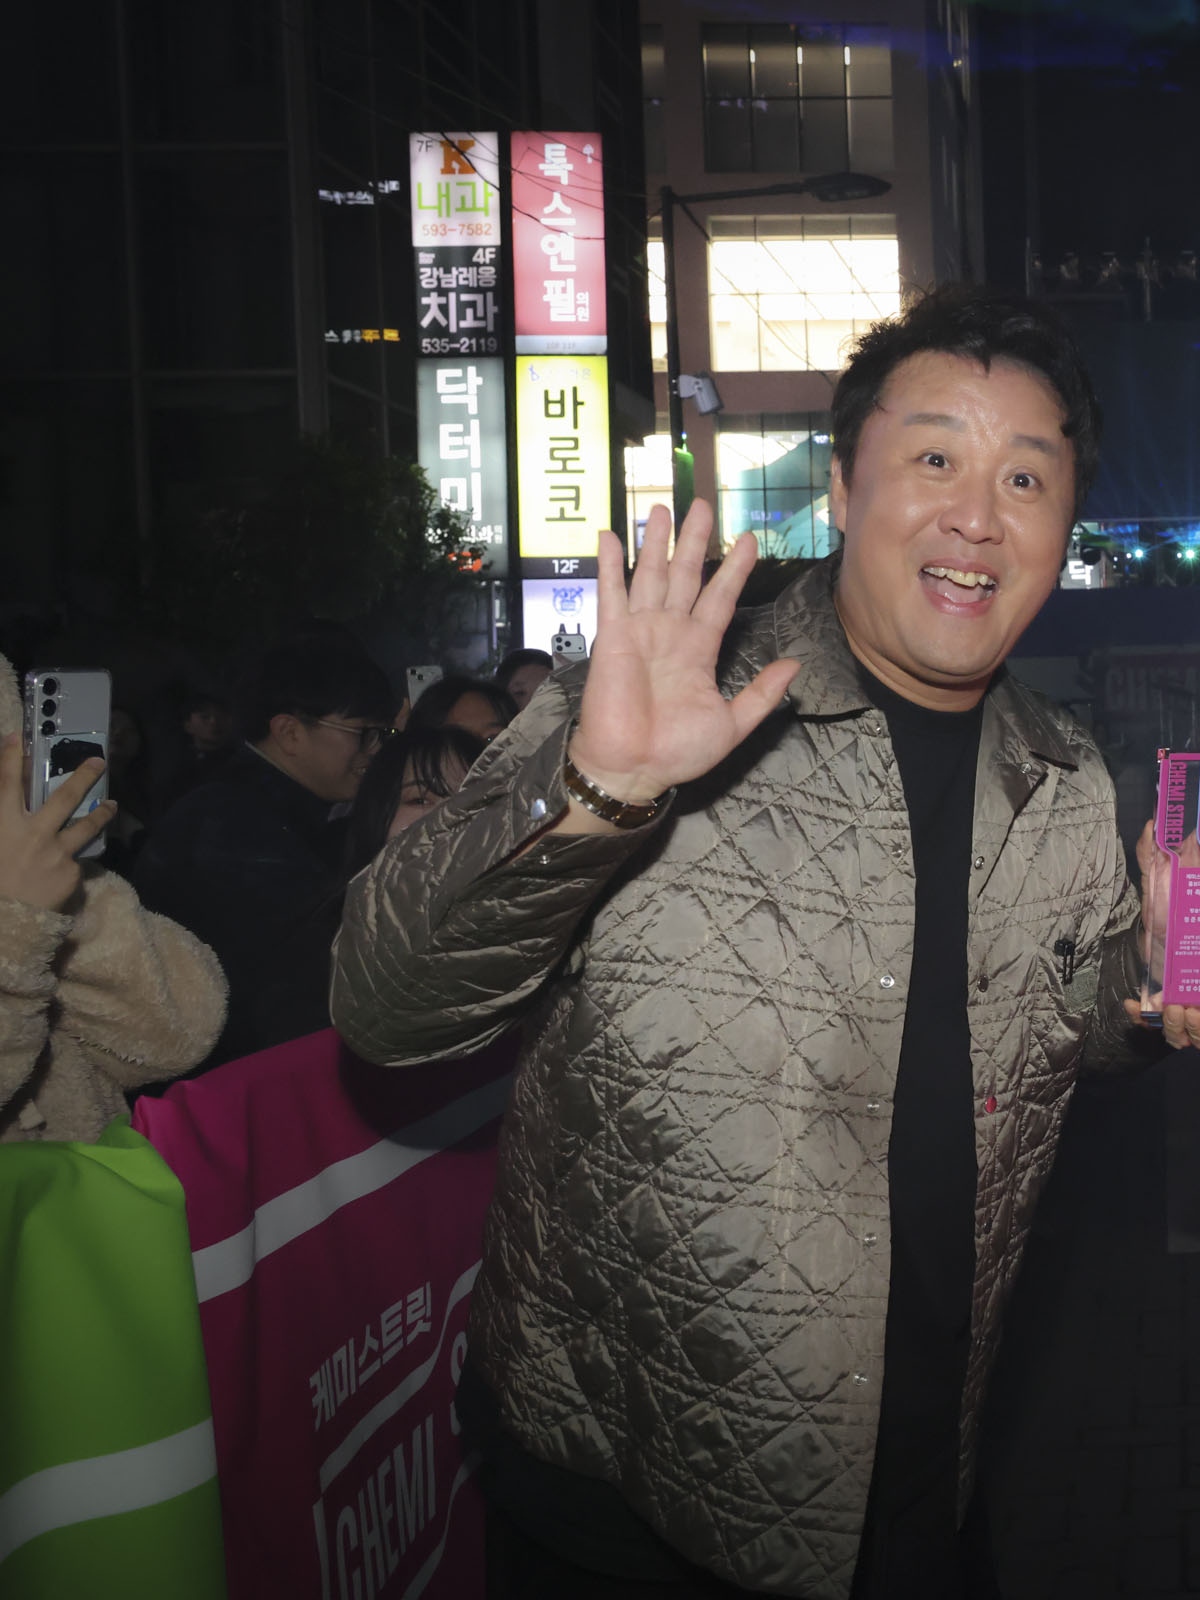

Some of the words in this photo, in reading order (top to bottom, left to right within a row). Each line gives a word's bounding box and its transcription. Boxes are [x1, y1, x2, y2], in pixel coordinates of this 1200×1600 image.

[417, 140, 433, 152] 7F
[440, 140, 475, 174] K
[417, 181, 494, 217] 내과
[422, 223, 492, 236] 593-7582
[472, 248, 496, 264] 4F
[420, 291, 498, 333] 치과
[421, 338, 497, 353] 535-2119
[436, 366, 483, 521] 닥터미
[544, 386, 586, 522] 바로코
[552, 559, 580, 574] 12F
[1168, 761, 1188, 801] CHEMI
[1165, 804, 1184, 848] STREET
[308, 1281, 432, 1433] 케미스트릿
[336, 1413, 436, 1600] CHEMI
